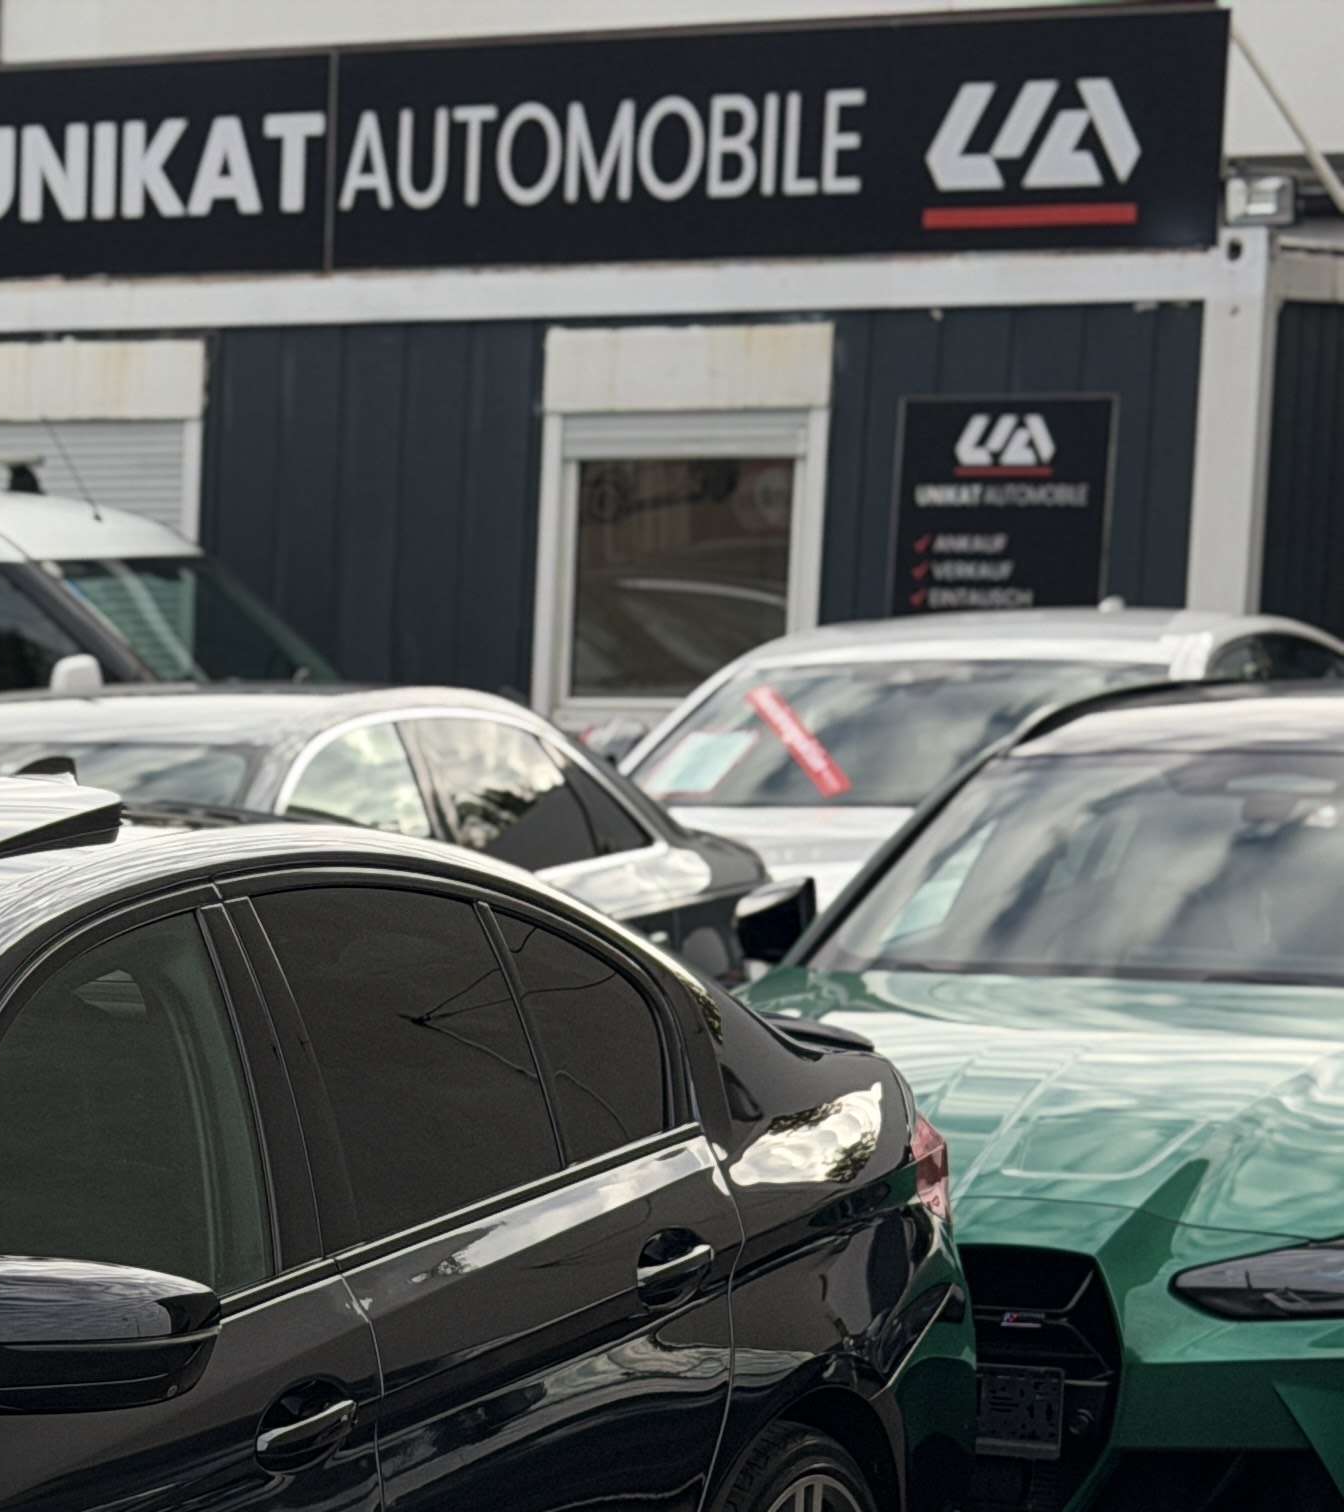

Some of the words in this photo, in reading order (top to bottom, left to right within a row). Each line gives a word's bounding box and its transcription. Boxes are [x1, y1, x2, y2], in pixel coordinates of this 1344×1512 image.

[338, 89, 867, 210] AUTOMOBILE
[915, 484, 983, 507] UNIKAT
[984, 483, 1089, 507] AUTOMOBILE
[933, 533, 1008, 553] ANKAUF
[931, 559, 1014, 580] VERKAUF
